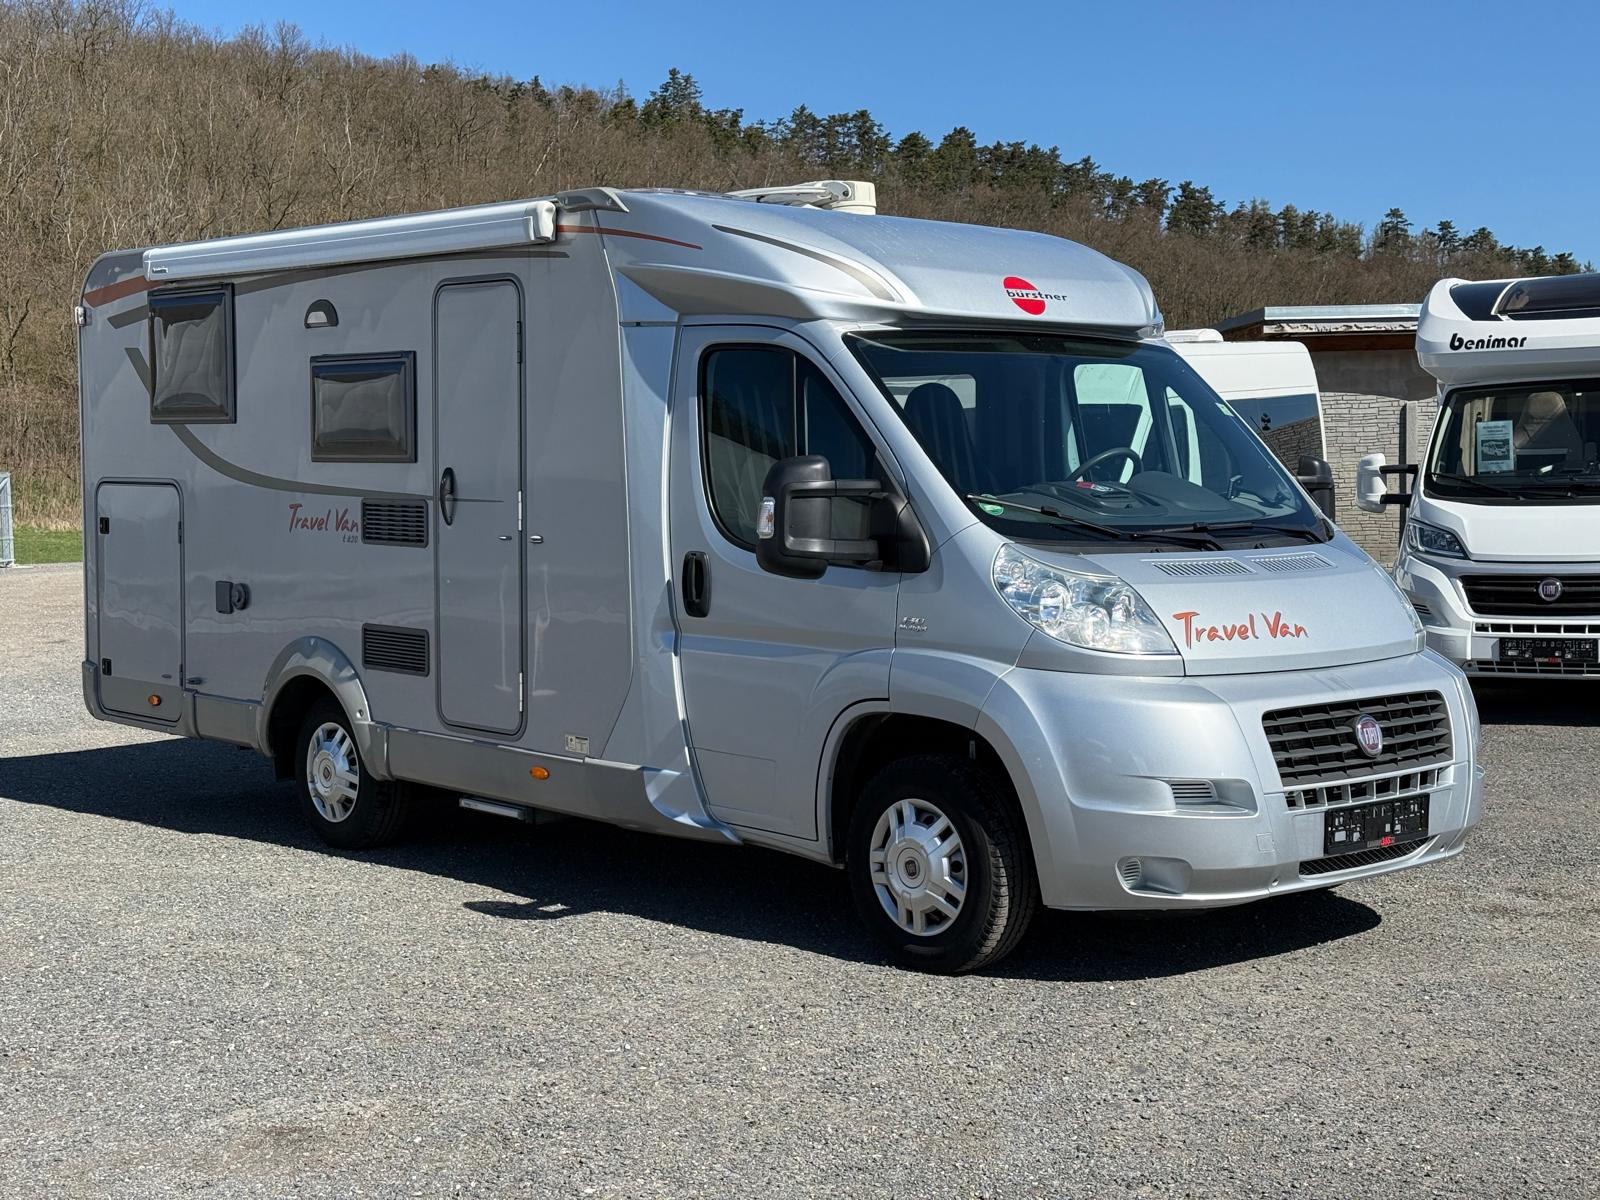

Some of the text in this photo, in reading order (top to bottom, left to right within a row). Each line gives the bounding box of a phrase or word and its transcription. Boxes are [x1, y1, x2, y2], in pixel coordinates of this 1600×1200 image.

[1006, 289, 1068, 302] bürstner
[1449, 332, 1528, 352] benimar
[288, 503, 359, 534] Travel Van
[1172, 611, 1310, 651] Travel Van
